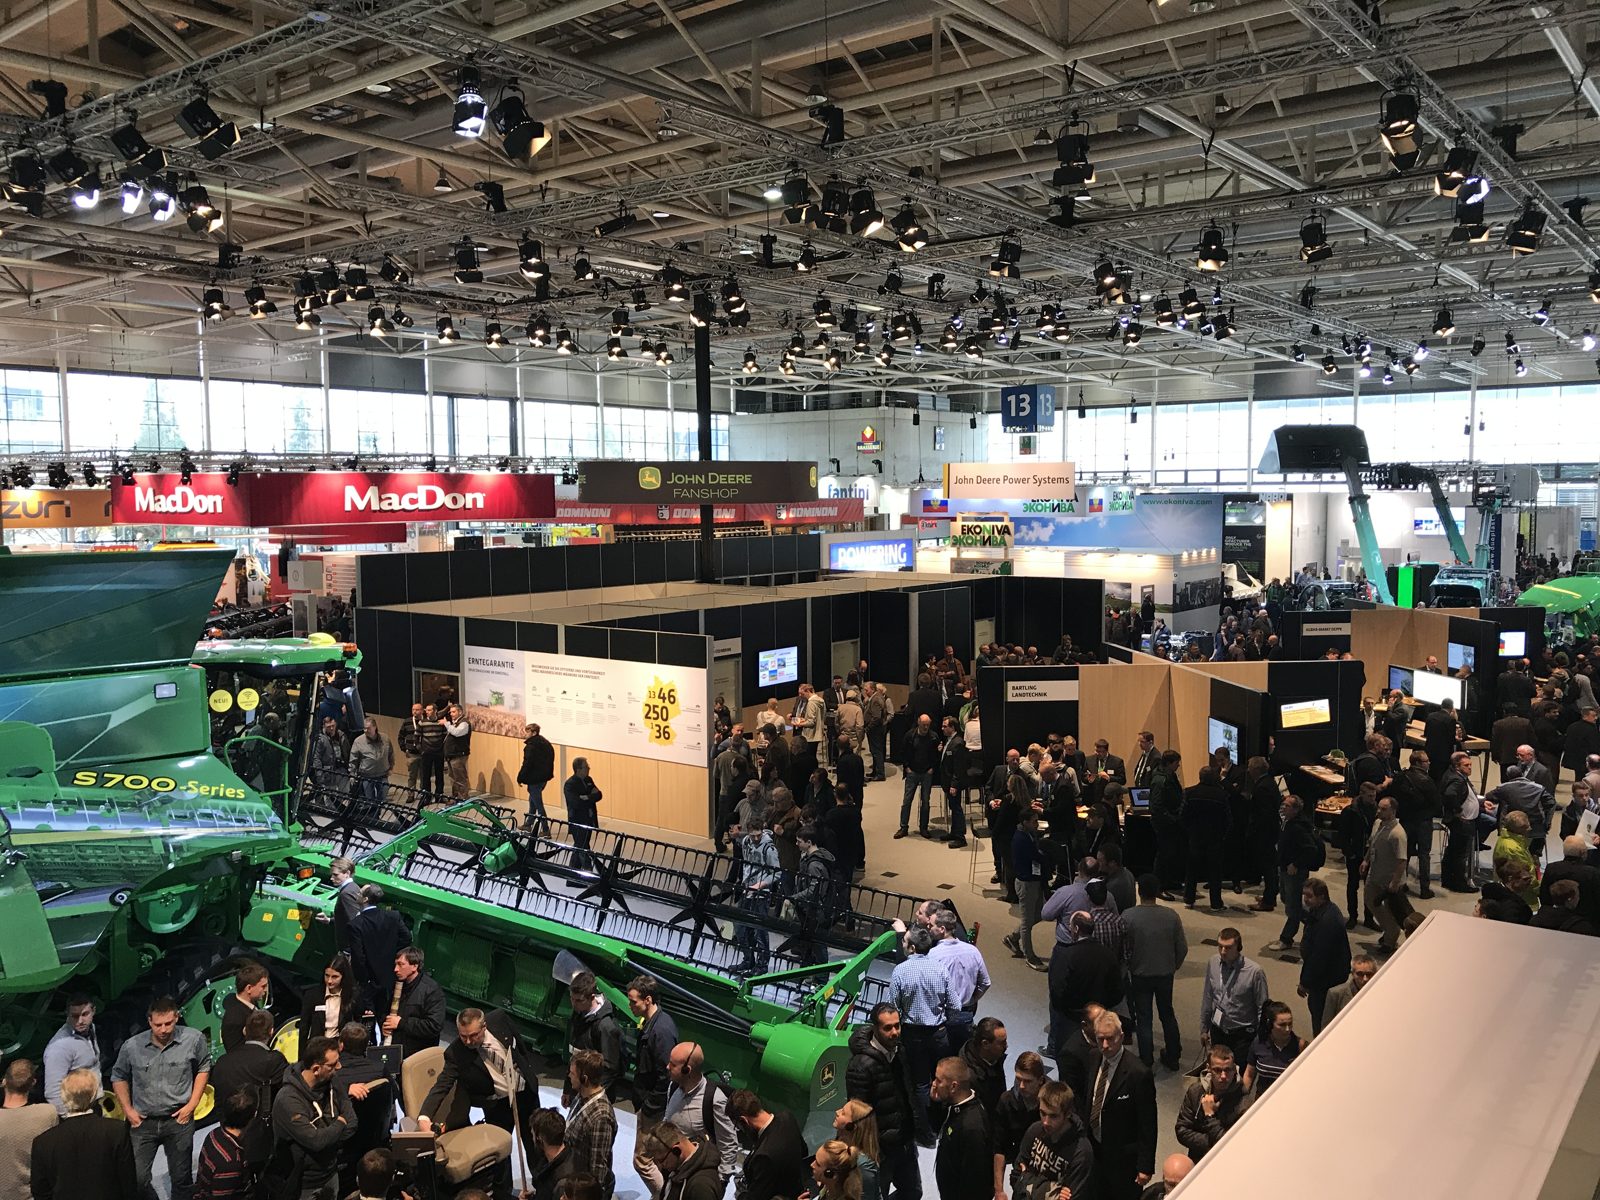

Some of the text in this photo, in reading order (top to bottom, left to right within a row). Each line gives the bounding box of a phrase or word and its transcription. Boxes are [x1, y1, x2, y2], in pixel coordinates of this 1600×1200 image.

[1007, 393, 1031, 417] 13
[1039, 393, 1052, 417] 13
[667, 473, 753, 484] JOHN DEERE
[954, 474, 1070, 487] John Deere Power Systems
[344, 485, 486, 511] MacDon
[673, 488, 739, 498] FANSHOP
[134, 486, 223, 513] MacDon
[788, 506, 838, 518] DOMINONI
[1022, 503, 1075, 513] ЭКОНИВА
[960, 524, 1012, 536] EKONIVA
[951, 535, 1008, 547] ЭКОНИВА
[838, 543, 907, 568] POWERING
[467, 657, 515, 669] ERNTEGARANTIE
[644, 703, 669, 722] 250
